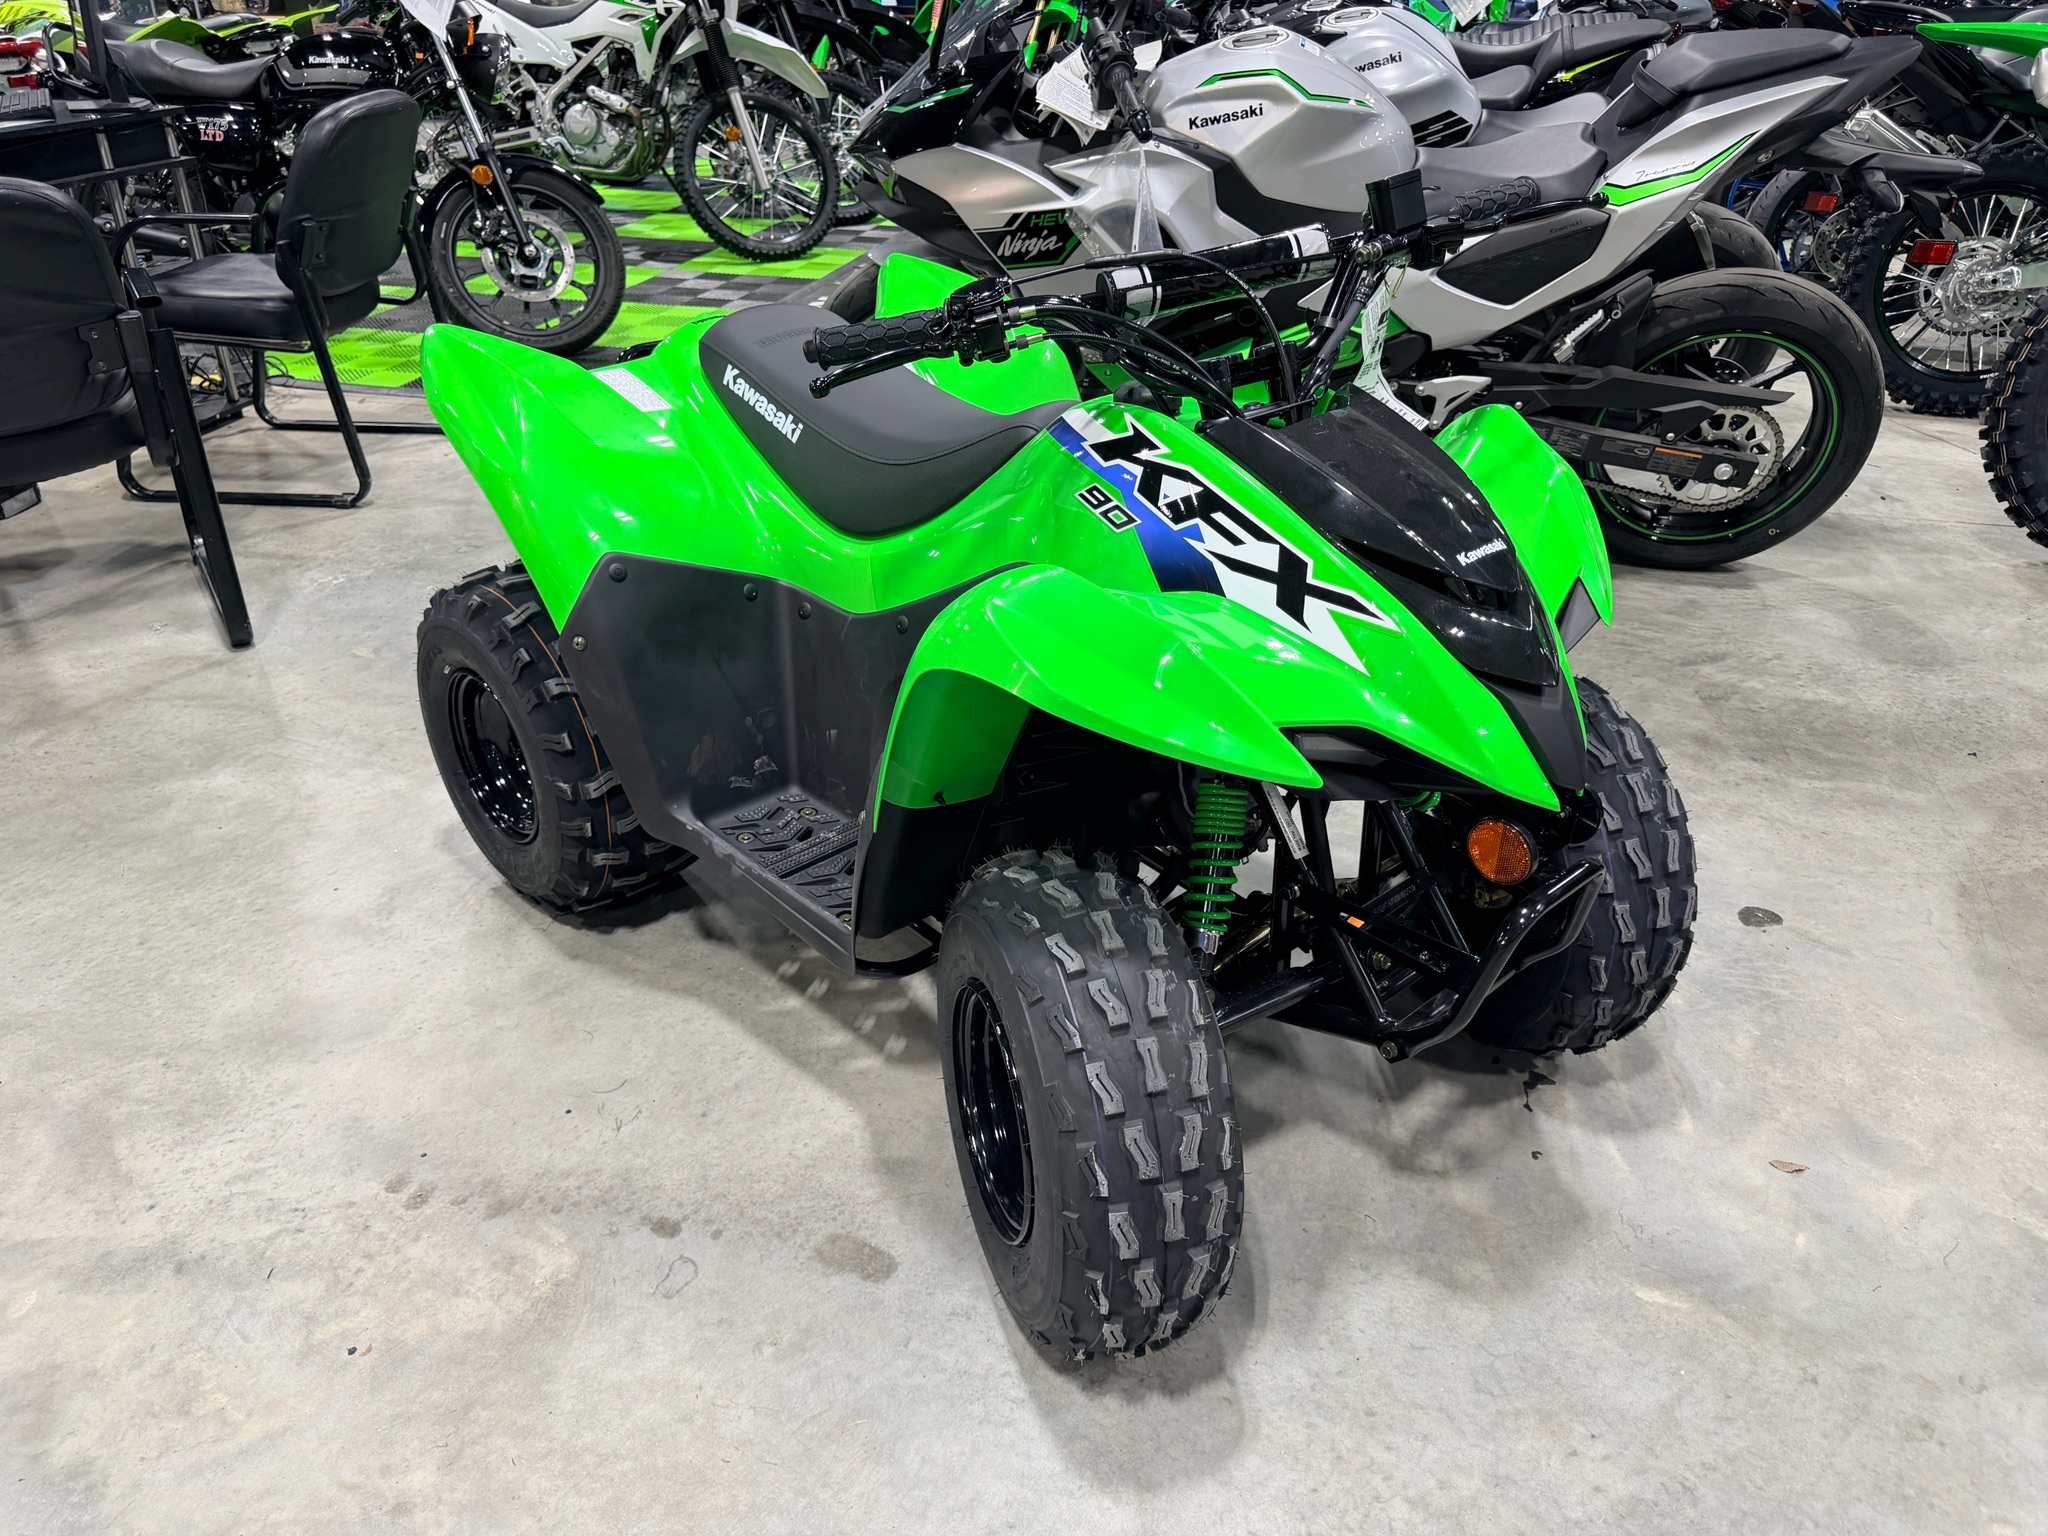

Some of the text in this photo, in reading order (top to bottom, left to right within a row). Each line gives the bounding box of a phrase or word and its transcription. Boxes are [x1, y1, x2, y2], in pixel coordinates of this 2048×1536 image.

[308, 55, 350, 64] Kawasaki
[1355, 51, 1403, 73] wasaki
[196, 116, 229, 131] W175
[1188, 103, 1263, 130] Kawasaki
[199, 130, 225, 142] LTD
[996, 229, 1063, 260] Ninja
[722, 363, 804, 444] Kawasaki
[1075, 483, 1141, 531] 90
[1086, 420, 1390, 636] KFX
[1456, 538, 1508, 567] Kawasaki
